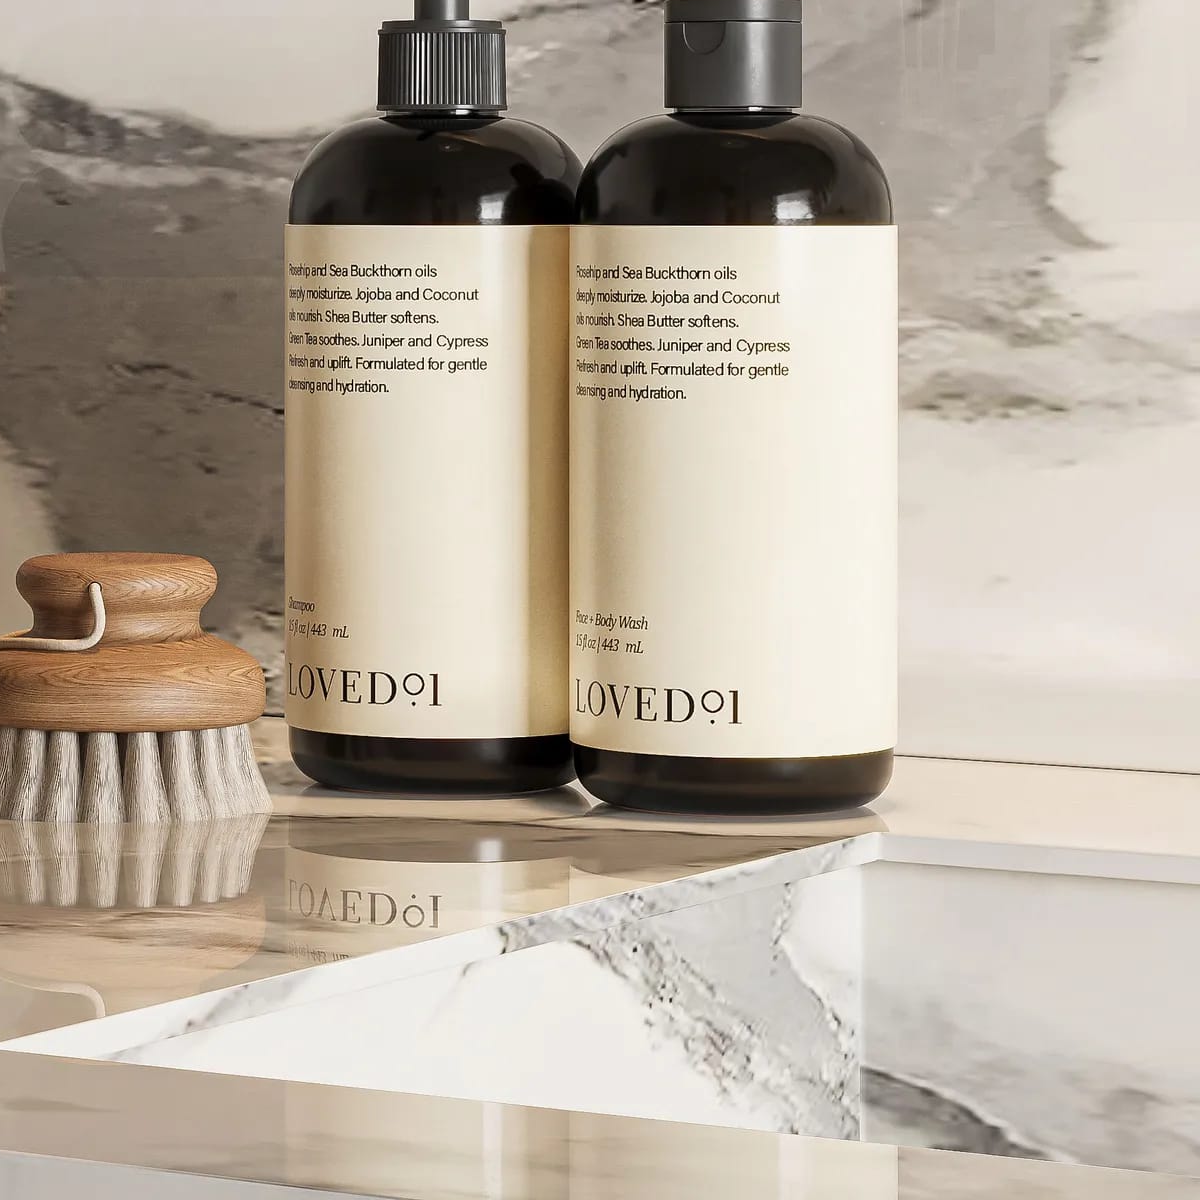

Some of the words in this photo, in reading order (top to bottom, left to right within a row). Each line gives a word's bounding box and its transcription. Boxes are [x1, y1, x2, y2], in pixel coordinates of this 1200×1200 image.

[311, 264, 327, 277] and
[329, 265, 348, 277] Sea
[351, 264, 412, 277] Buckthorn
[416, 264, 437, 277] oils
[576, 265, 601, 280] Rosehip
[602, 266, 619, 279] and
[622, 267, 642, 279] Sea
[646, 267, 710, 280] Buckthorn
[714, 267, 737, 280] oils
[307, 287, 352, 300] moisturize.
[355, 288, 392, 303] Jojoba
[396, 288, 419, 300] and
[423, 288, 479, 301] Coconut
[576, 289, 596, 304] deeply
[597, 290, 647, 303] moisturize.
[650, 291, 689, 306] Jojoba
[693, 291, 718, 304] and
[722, 291, 780, 304] Coconut
[297, 310, 323, 322] nourish.
[325, 311, 349, 323] Shea
[352, 311, 387, 323] Butter
[391, 311, 439, 324] softens.
[586, 313, 615, 326] nourish.
[618, 314, 644, 327] Shea
[647, 315, 685, 327] Butter
[688, 315, 739, 328] softens.
[289, 332, 303, 344] Green
[304, 333, 317, 345] Tea
[319, 333, 359, 346] soothes.
[362, 334, 404, 349] Juniper
[408, 334, 432, 347] and
[436, 335, 488, 350] Cypress
[576, 336, 593, 349] Green
[594, 337, 609, 349] Tea
[611, 338, 655, 351] soothes.
[657, 339, 702, 354] Juniper
[706, 339, 731, 352] and
[737, 339, 790, 355] Cypress
[310, 356, 325, 368] and
[327, 356, 352, 371] uplift.
[356, 357, 424, 370] Formulated
[428, 357, 444, 370] for
[448, 358, 487, 373] gentle
[576, 359, 599, 374] Refresh
[600, 361, 617, 374] and
[620, 362, 647, 377] uplift.
[651, 363, 724, 376] Formulated
[727, 363, 745, 376] for
[748, 363, 789, 379] gentle
[316, 380, 333, 392] and
[335, 380, 389, 395] hydration.
[576, 384, 606, 400] cleansing
[608, 386, 626, 398] and
[629, 386, 686, 401] hydration.
[576, 610, 588, 624] Face
[595, 614, 616, 631] Body
[619, 616, 648, 630] Wash
[311, 624, 327, 636] 443
[332, 626, 349, 638] mL
[602, 638, 619, 651] 443
[625, 641, 644, 654] mL
